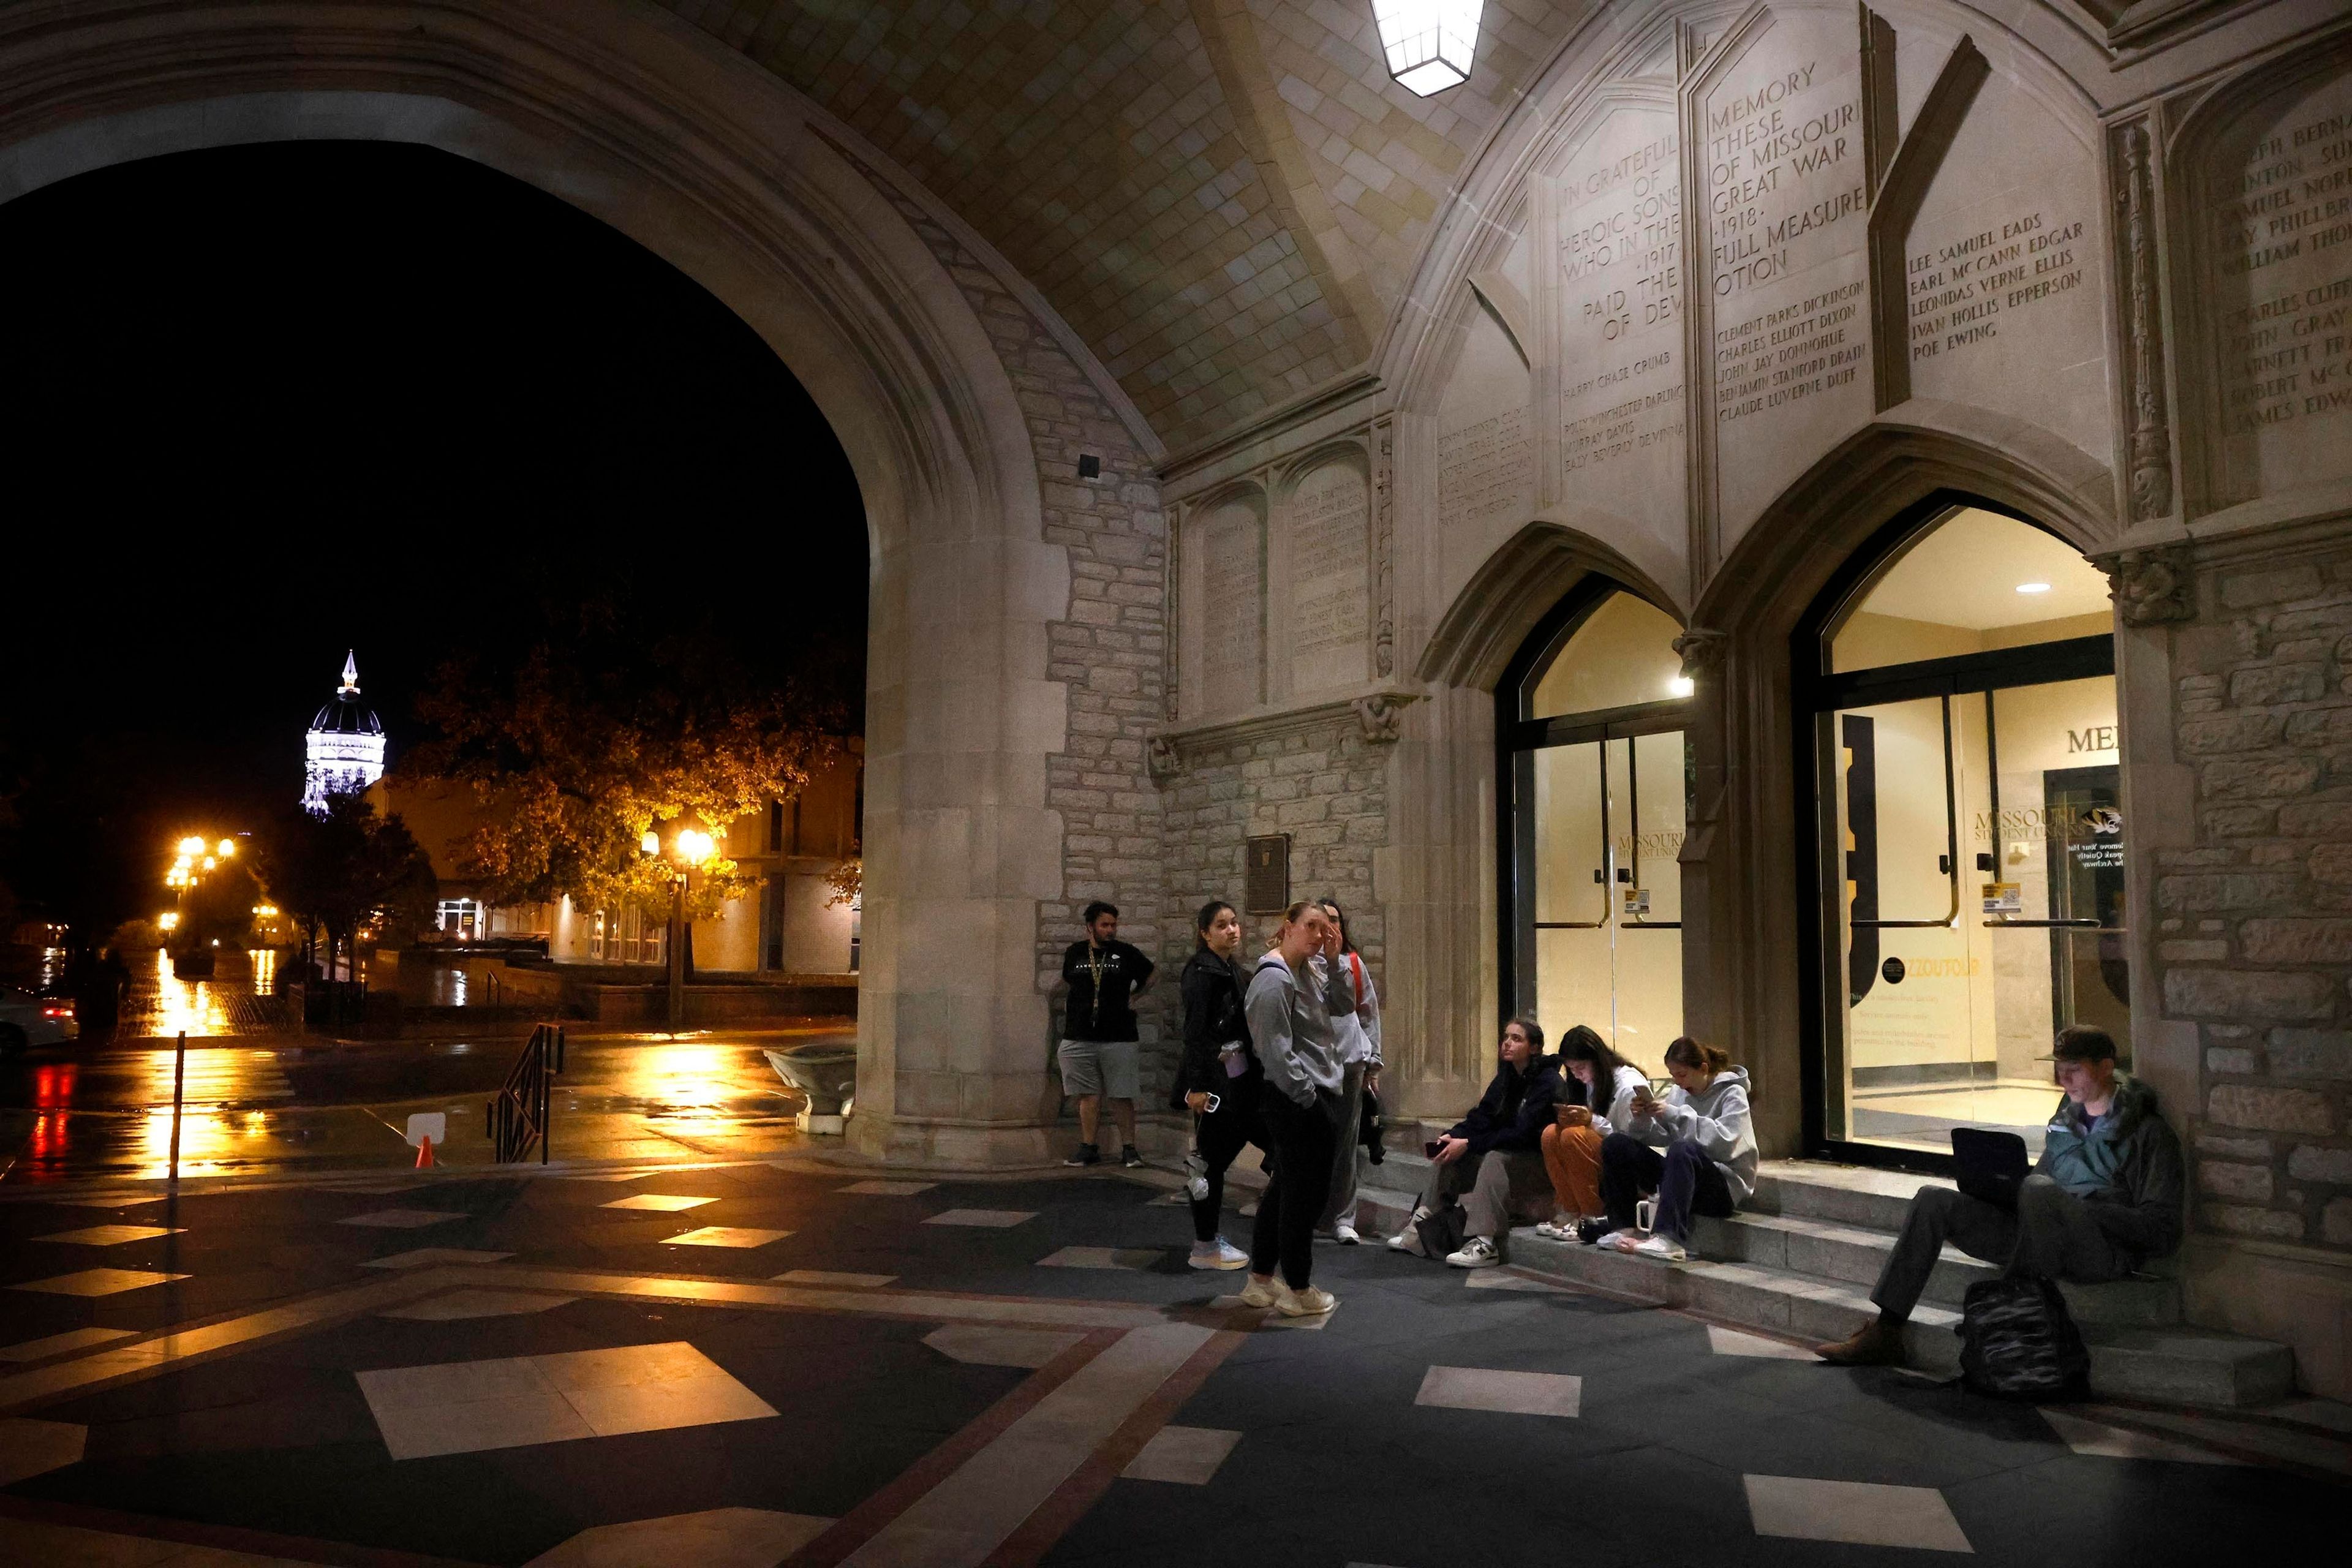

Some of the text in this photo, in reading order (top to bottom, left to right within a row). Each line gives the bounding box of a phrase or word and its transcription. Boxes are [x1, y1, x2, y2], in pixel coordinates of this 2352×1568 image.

[1712, 62, 1815, 133] MEMORY
[1712, 109, 1784, 160] THESE
[1712, 99, 1860, 186] OF MISSOURI
[1586, 135, 1677, 194] GRATEFUL
[1634, 169, 1660, 197] OF
[1713, 137, 1848, 214] GREAT WAR
[1561, 212, 1626, 257] HEROIC
[1562, 213, 1680, 282] WHO IN THE
[1714, 187, 1863, 270] FULL MEASURE
[1909, 213, 2041, 274] LEE SAMUEL EADS
[1636, 267, 1678, 301] THE
[1714, 249, 1787, 296] OTION
[1910, 271, 1945, 296] EARL
[2029, 222, 2082, 255] EDGAR
[1910, 249, 2075, 317] LEONIDAS VERNE ELLIS
[1584, 290, 1626, 325] PAID
[1718, 280, 1864, 344] CLEMENT PARKS DICKINSON
[1951, 299, 2000, 327] HOLLIS
[2008, 270, 2082, 309] EPPERSON
[1603, 313, 1630, 341] OF
[1719, 304, 1856, 363] CHARLES ELLIOTT DIXON
[1913, 322, 1997, 361] POE EWING
[1598, 367, 1630, 388] CHASE
[1634, 352, 1671, 375] CRUMB
[1720, 362, 1748, 384] JOHN
[1754, 353, 1774, 372] JAY
[1720, 342, 1866, 404] BENJAMIN STANFORD DRAIN
[1720, 367, 1856, 423] CLAUDE LUVERNE DUFF
[1607, 420, 1635, 441] DAVIS
[2068, 726, 2120, 753] ME
